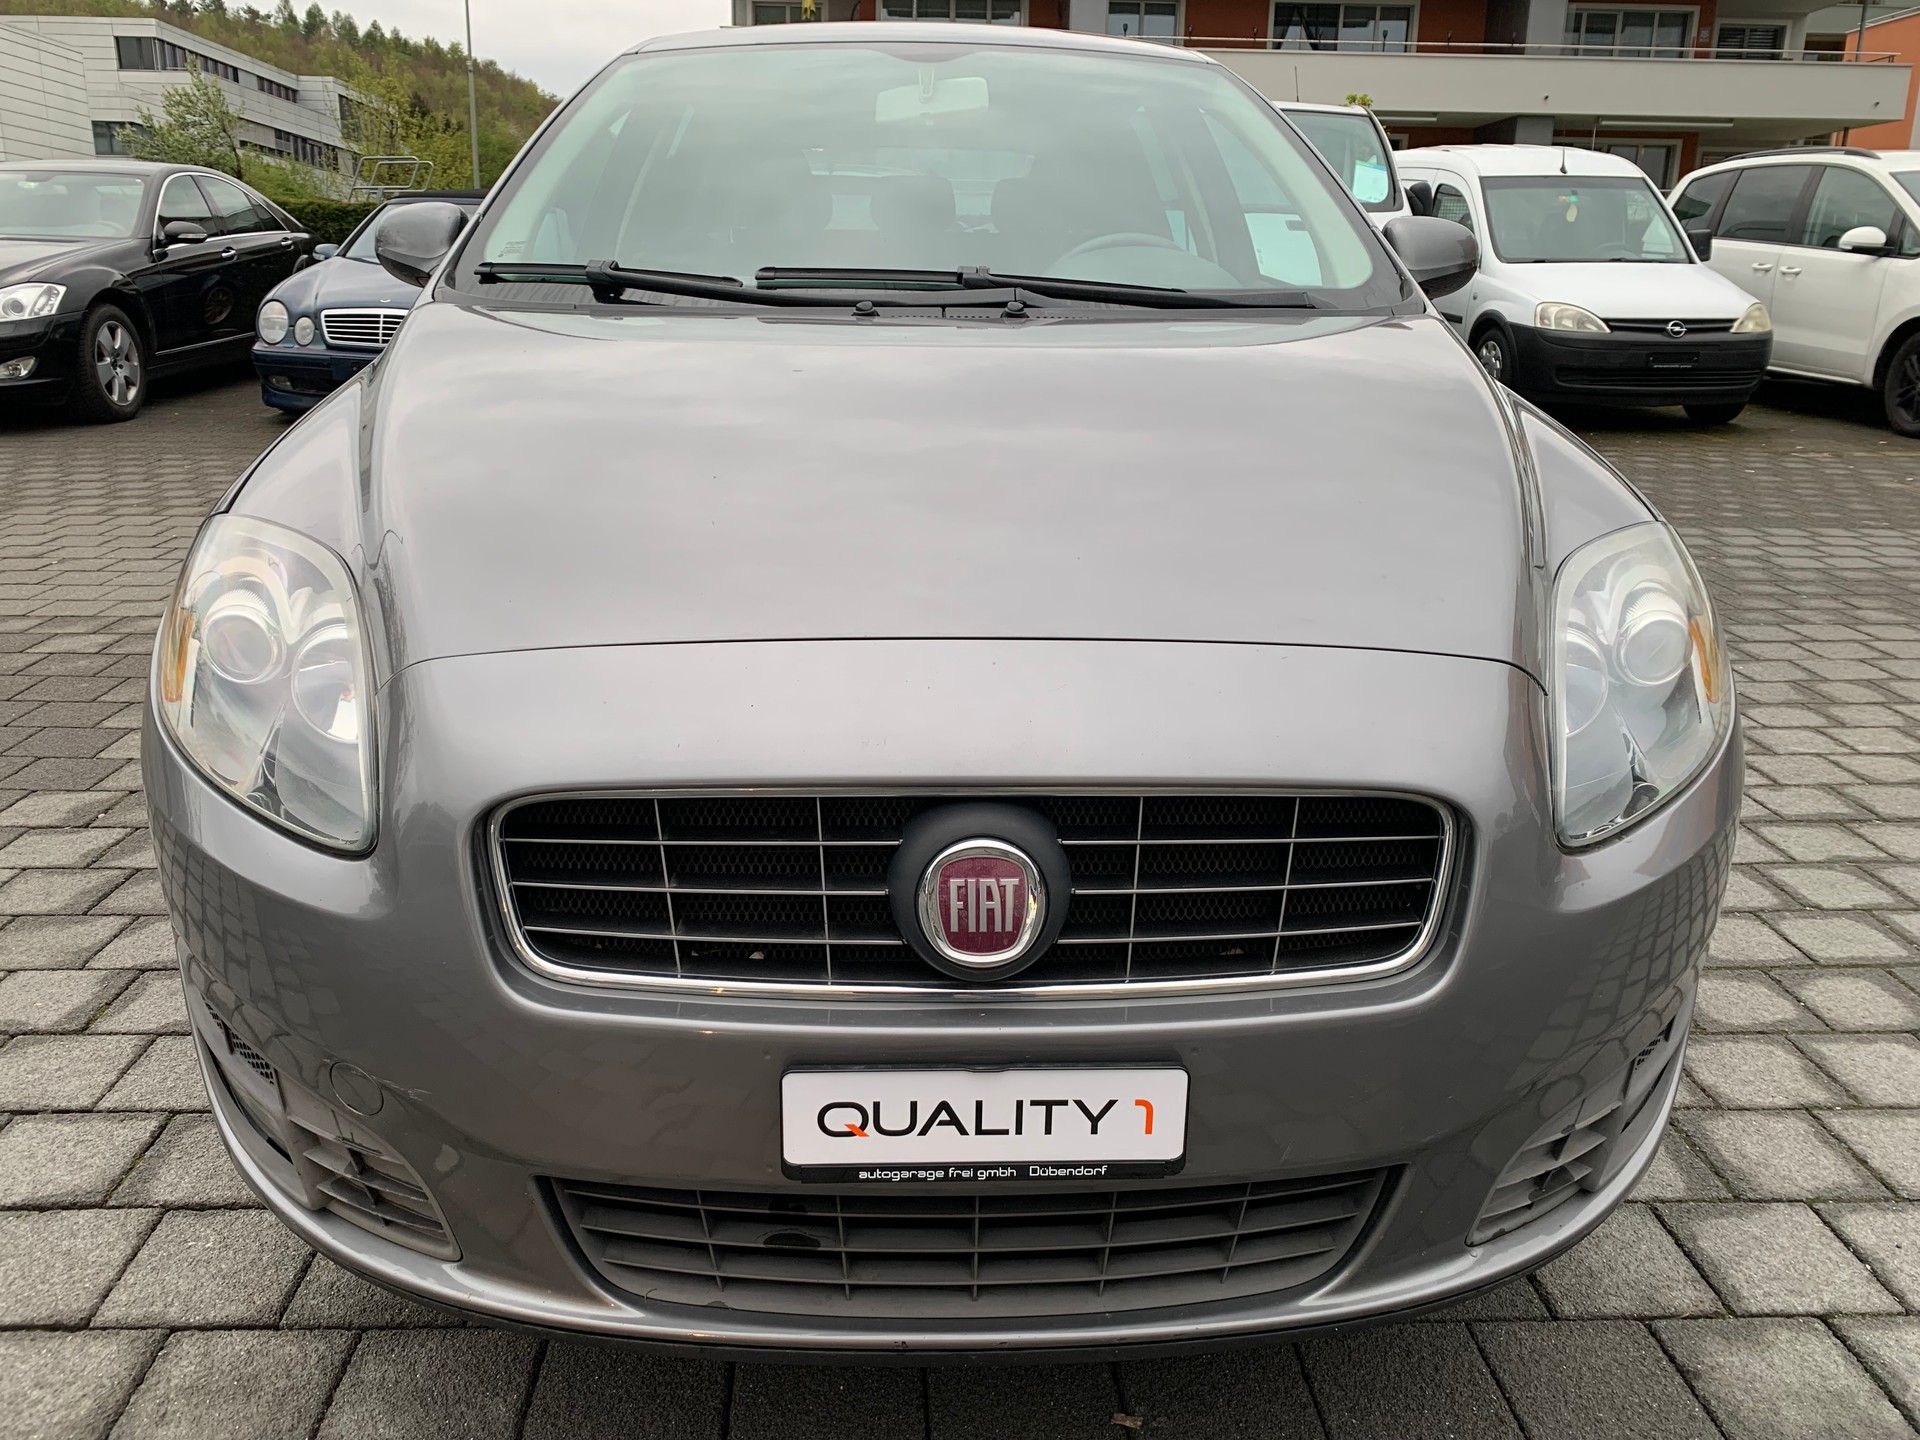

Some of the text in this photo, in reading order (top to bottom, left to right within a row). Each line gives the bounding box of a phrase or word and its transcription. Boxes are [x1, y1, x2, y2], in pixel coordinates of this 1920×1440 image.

[949, 877, 1019, 933] FIAT
[817, 1099, 1154, 1138] QUALITY 1
[858, 1165, 1108, 1181] autogarage frei gmbh Dübendorf
